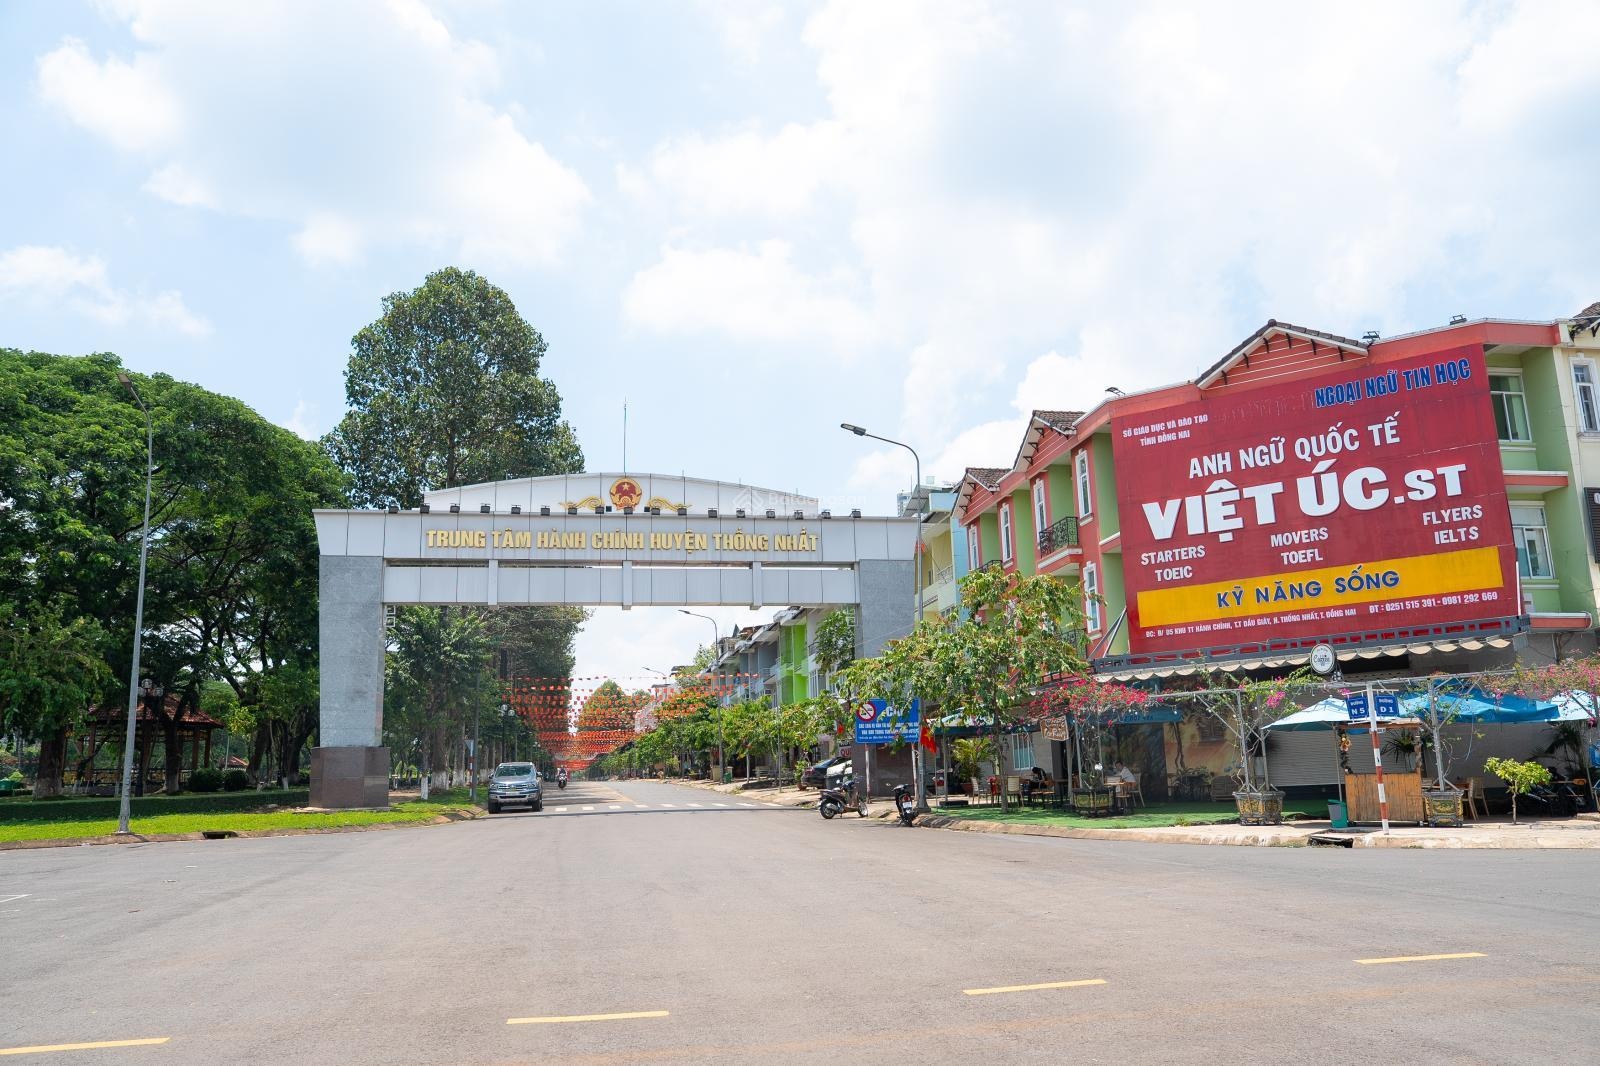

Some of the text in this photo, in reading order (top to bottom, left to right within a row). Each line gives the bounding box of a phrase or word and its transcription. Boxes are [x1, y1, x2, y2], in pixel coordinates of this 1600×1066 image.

[1315, 380, 1362, 409] NGOẠI
[1364, 369, 1398, 398] NGỮ
[1402, 366, 1432, 391] TIN
[1434, 358, 1472, 386] HỌC
[1133, 425, 1150, 437] GIÁO
[1193, 414, 1209, 425] TẠO
[1178, 429, 1191, 440] NAI
[1189, 411, 1401, 479] ANH NGỮ QUỐC TẾ
[1141, 478, 1284, 543] VIỆT
[1422, 504, 1483, 526] FLYERS
[426, 526, 819, 554] TRUNG TÂM HÀNH CHÍNH HUYỆN THỐNG NHẤT
[1270, 527, 1329, 548] MOVERS
[1434, 526, 1480, 545] IELTS
[1140, 545, 1206, 566] STARTERS
[1281, 548, 1323, 565] TOEFL
[1154, 565, 1193, 582] TOEIC
[1216, 565, 1400, 608] KỸ NĂNG SỐNG
[1385, 602, 1404, 612] 0251
[1405, 600, 1420, 609] 515
[1421, 598, 1436, 608] 391
[1442, 595, 1462, 605] 0981
[1463, 593, 1480, 603] 292
[1481, 591, 1498, 601] 669
[1174, 626, 1186, 635] KHU
[1187, 625, 1194, 633] TT
[1195, 623, 1211, 633] HÀNH
[1280, 613, 1301, 624] THỐNG
[1344, 608, 1357, 616] NAI
